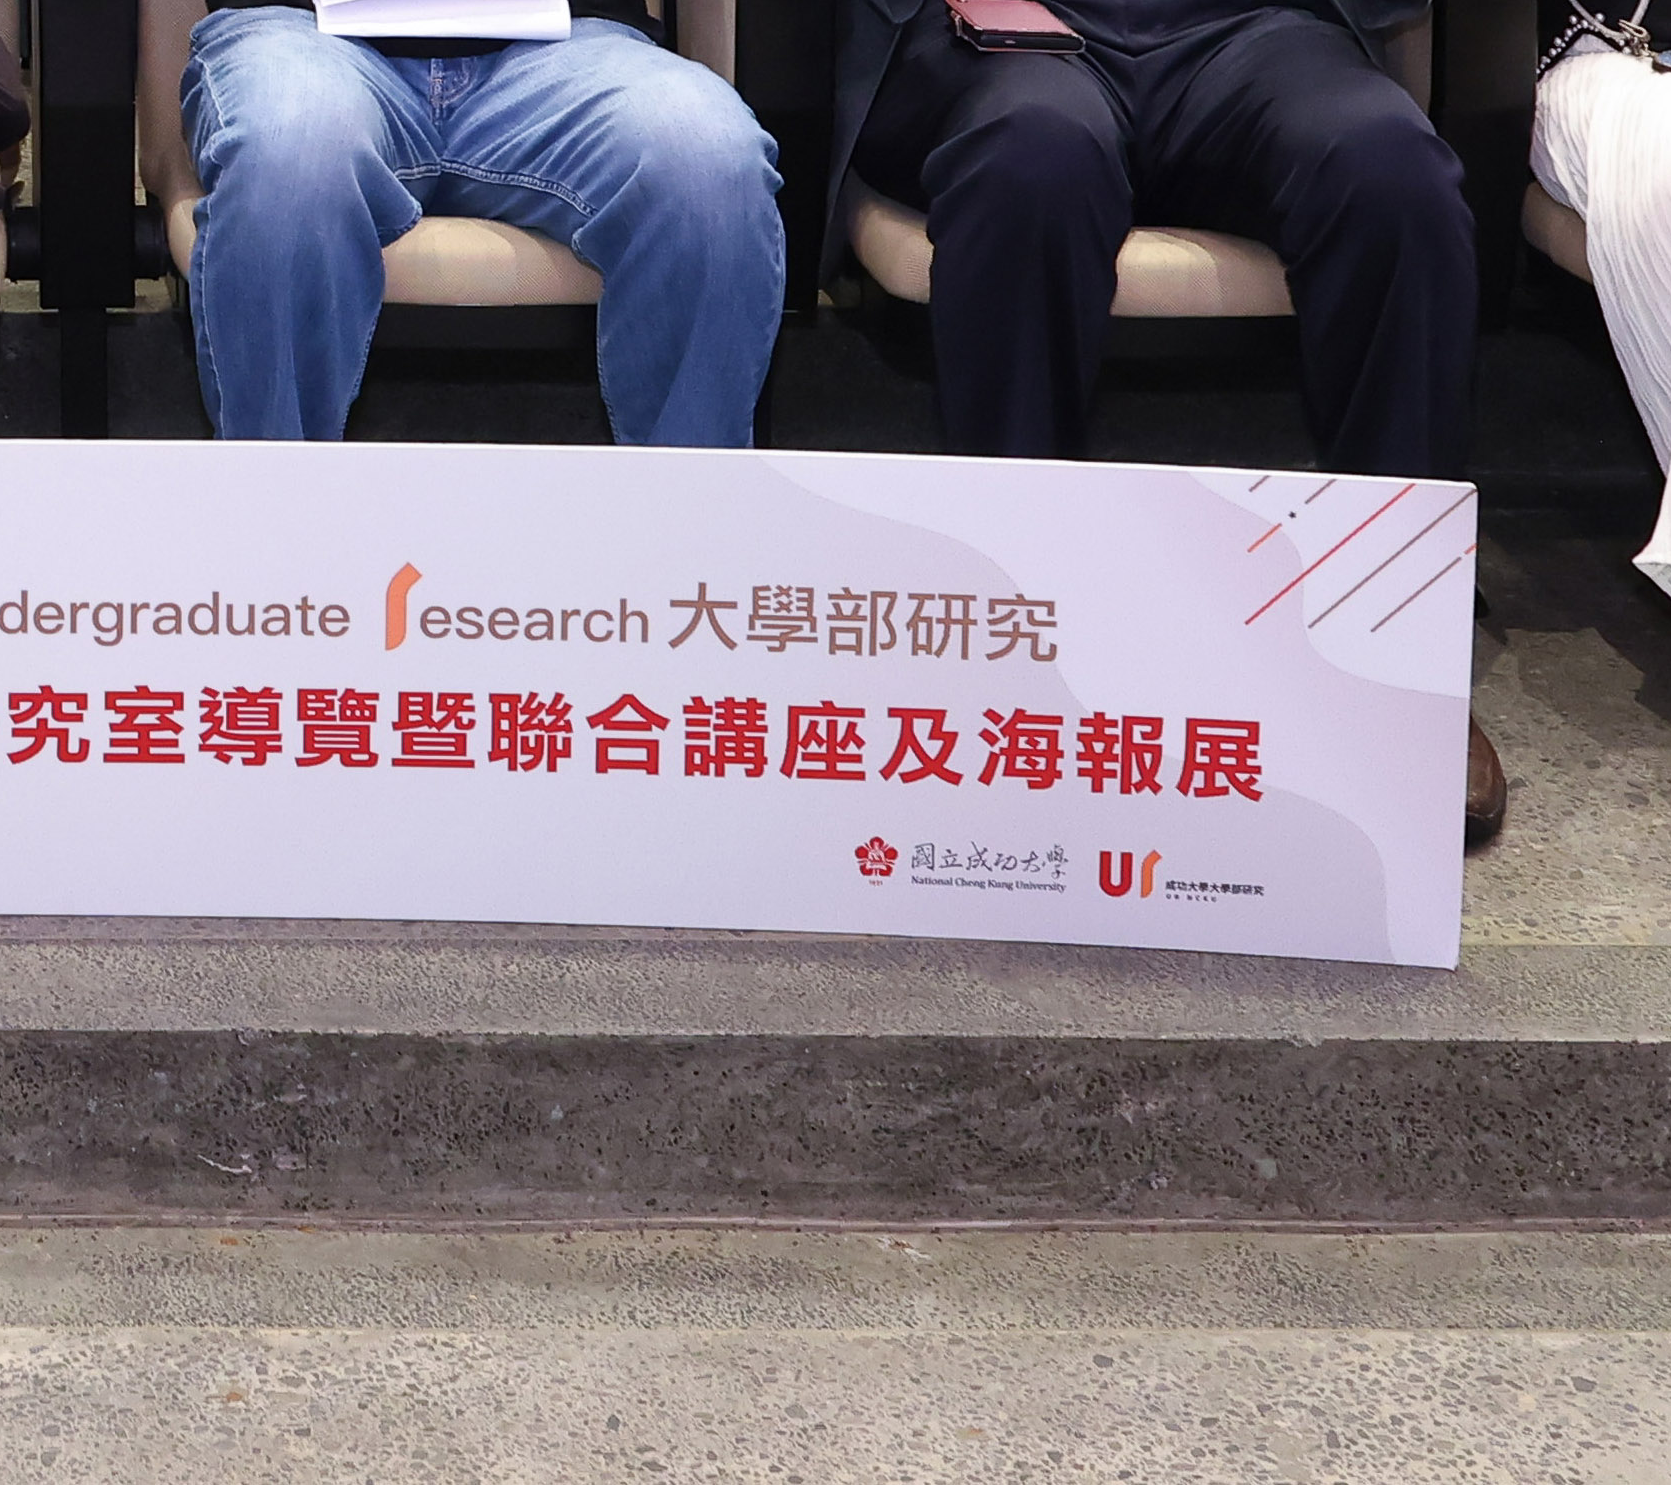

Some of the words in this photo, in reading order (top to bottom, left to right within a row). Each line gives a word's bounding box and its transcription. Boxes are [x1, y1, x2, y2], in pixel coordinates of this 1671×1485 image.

[667, 582, 1059, 663] 大學部研究
[910, 875, 954, 888] National
[955, 878, 987, 891] Cheng
[988, 880, 1014, 892] Kung
[1015, 882, 1067, 894] University
